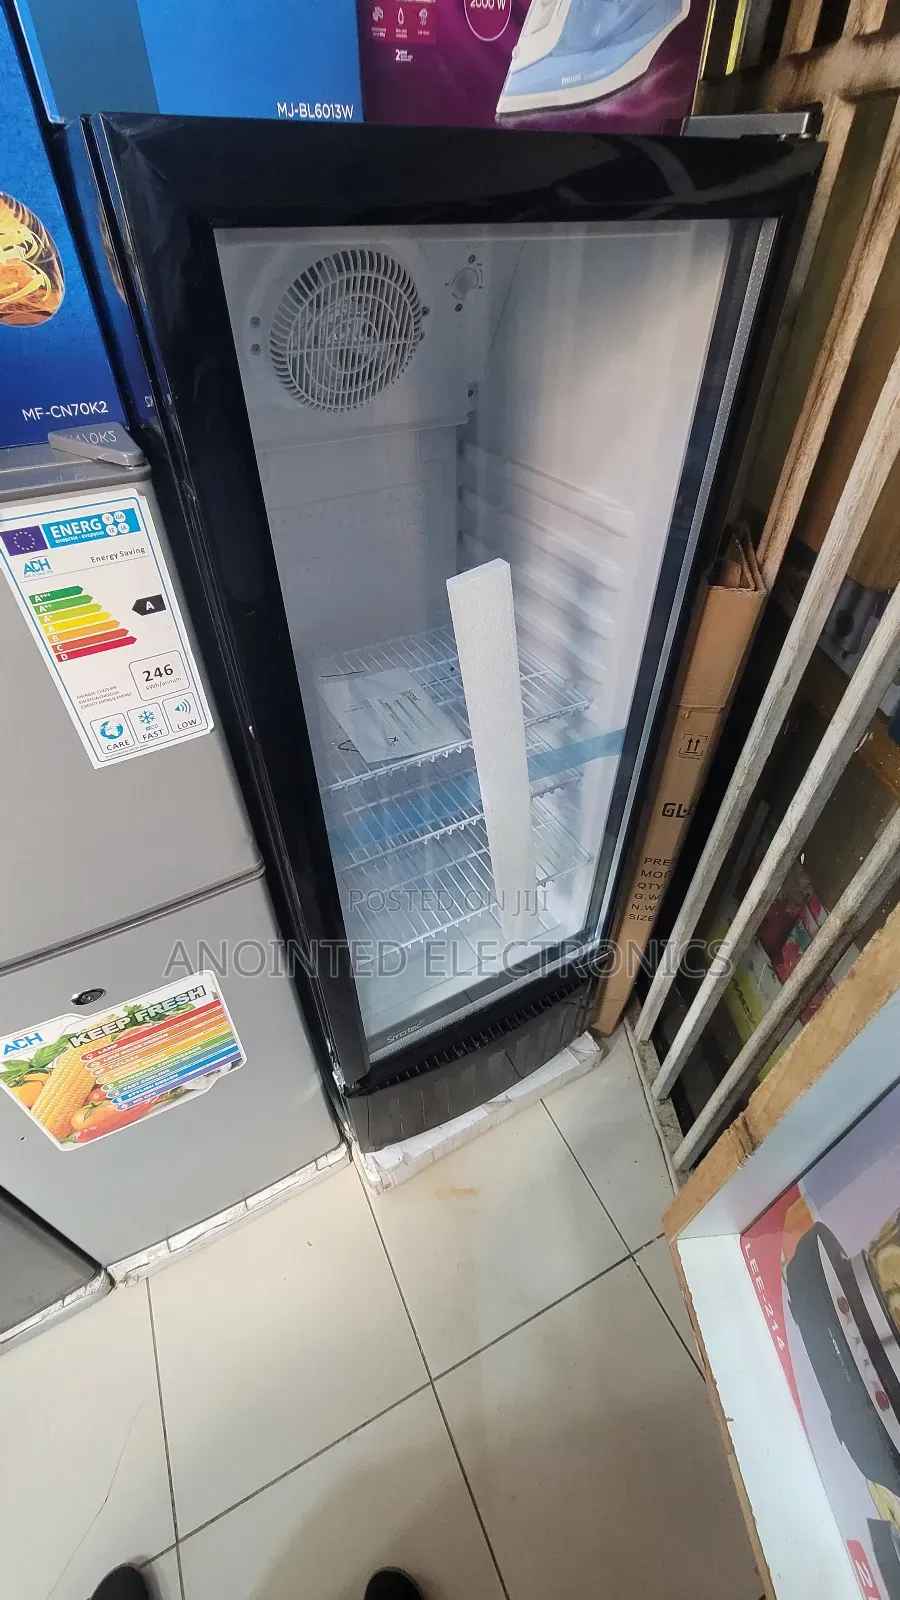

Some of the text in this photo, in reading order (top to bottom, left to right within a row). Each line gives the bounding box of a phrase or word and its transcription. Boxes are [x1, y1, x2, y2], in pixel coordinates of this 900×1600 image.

[277, 102, 354, 119] MJ-BL6013W
[22, 401, 109, 421] MF-CN70K2
[50, 518, 102, 538] ENERG
[90, 546, 146, 563] Energy Saving
[24, 558, 52, 575] ACH
[145, 601, 155, 611] A
[52, 634, 59, 642] B
[61, 653, 69, 661] D
[142, 664, 174, 682] 246
[146, 677, 182, 691] kWh/annum
[177, 719, 198, 730] LOW
[142, 729, 164, 741] FAST
[106, 740, 131, 752] CARE
[662, 802, 692, 819] GL
[69, 985, 207, 1048] KEEP FRESH
[3, 1032, 44, 1056] ACH
[98, 1043, 119, 1054] LAMP
[103, 1032, 169, 1063] LOW NOISE DESIGN
[118, 1046, 202, 1084] POWERFUL COMPRESSOR
[123, 1069, 170, 1091] FAST COOLING
[127, 1073, 179, 1098] STYLISH DESIGN
[744, 1242, 786, 1351] LEE-214
